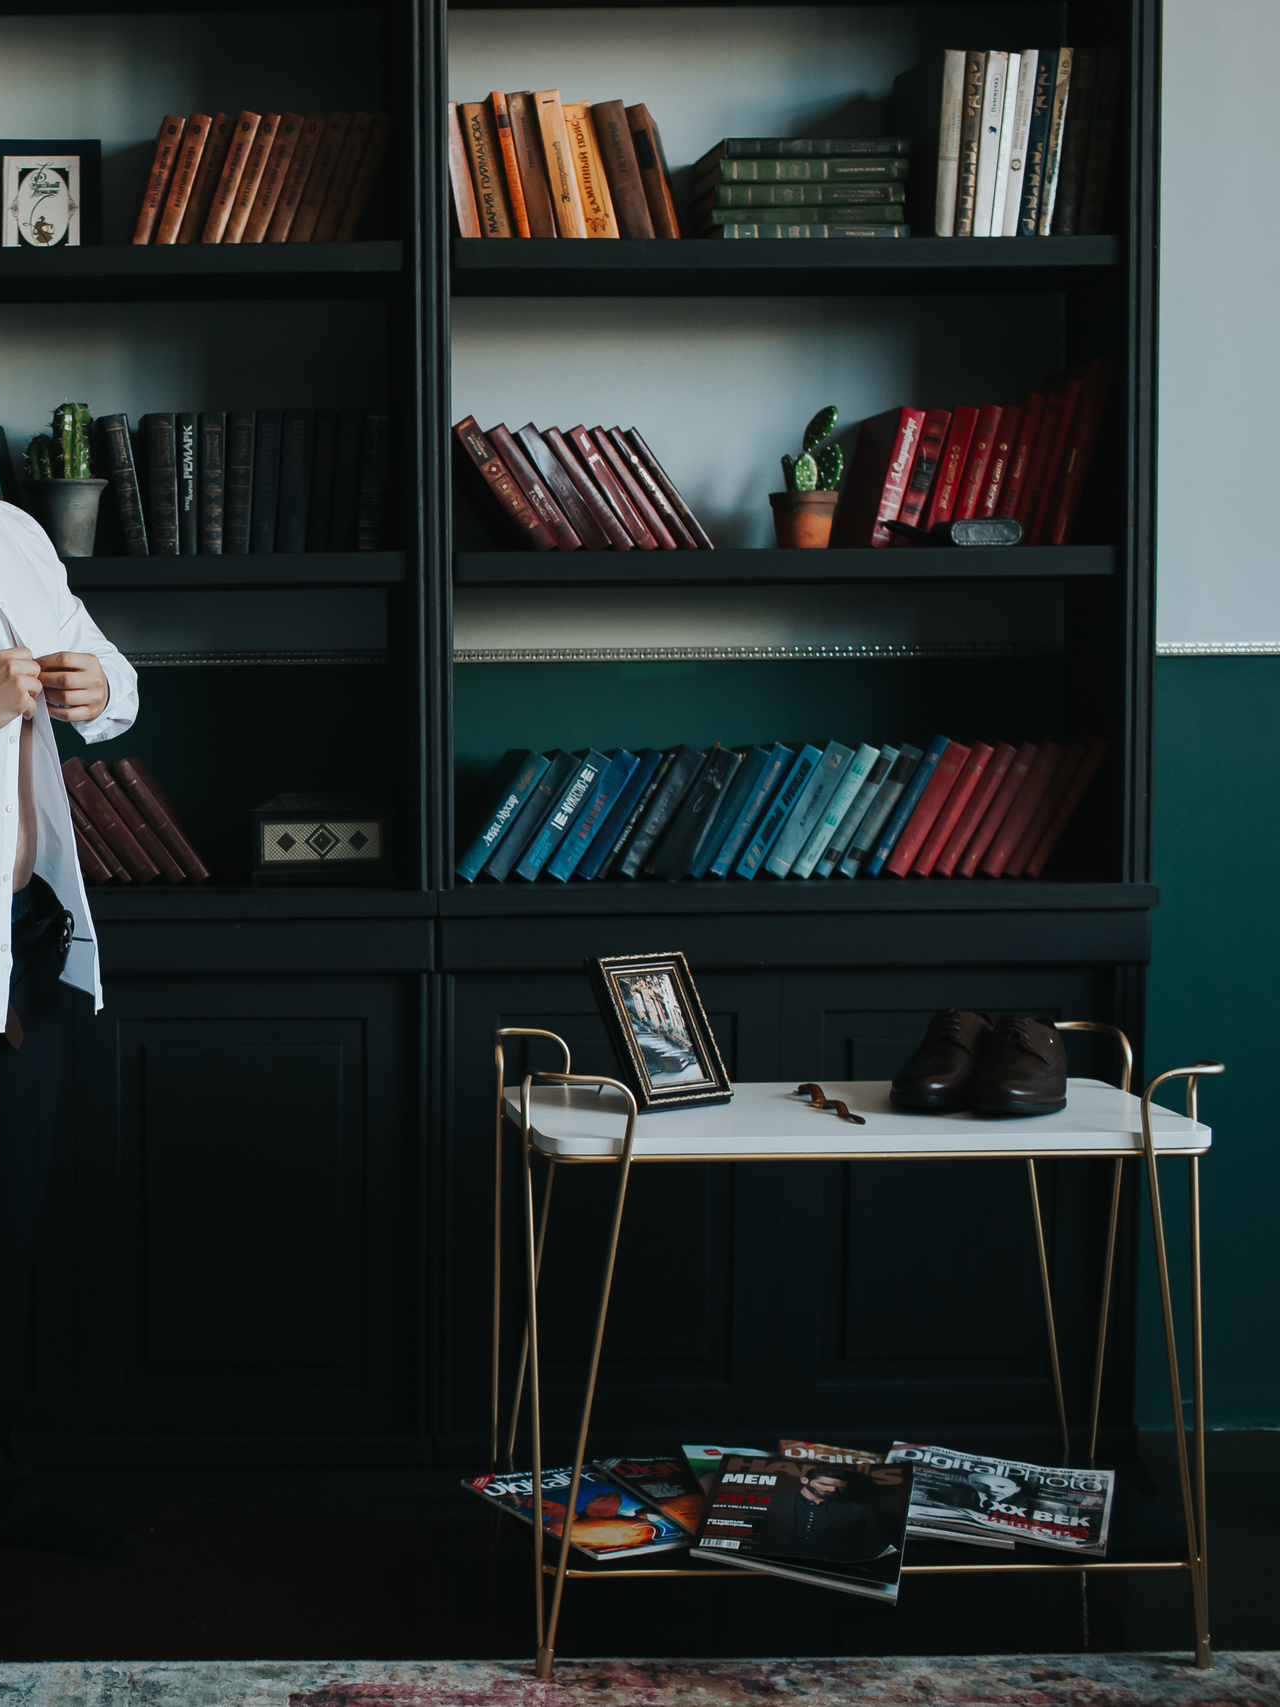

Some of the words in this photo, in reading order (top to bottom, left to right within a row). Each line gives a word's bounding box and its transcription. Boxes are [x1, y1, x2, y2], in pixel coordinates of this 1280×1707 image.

[990, 77, 1000, 113] Почемучка
[470, 114, 491, 189] ПУЙМАНОВА
[570, 119, 587, 149] ПОЯС
[576, 150, 602, 215] КАМЕННЫЙ
[483, 192, 499, 234] МАРИЯ
[182, 424, 194, 480] РЕМАРК
[559, 777, 590, 816] МУЖЕСТВО
[720, 1473, 778, 1487] MEN
[714, 1493, 772, 1505] 2019
[1032, 1509, 1091, 1527] ВЕК
